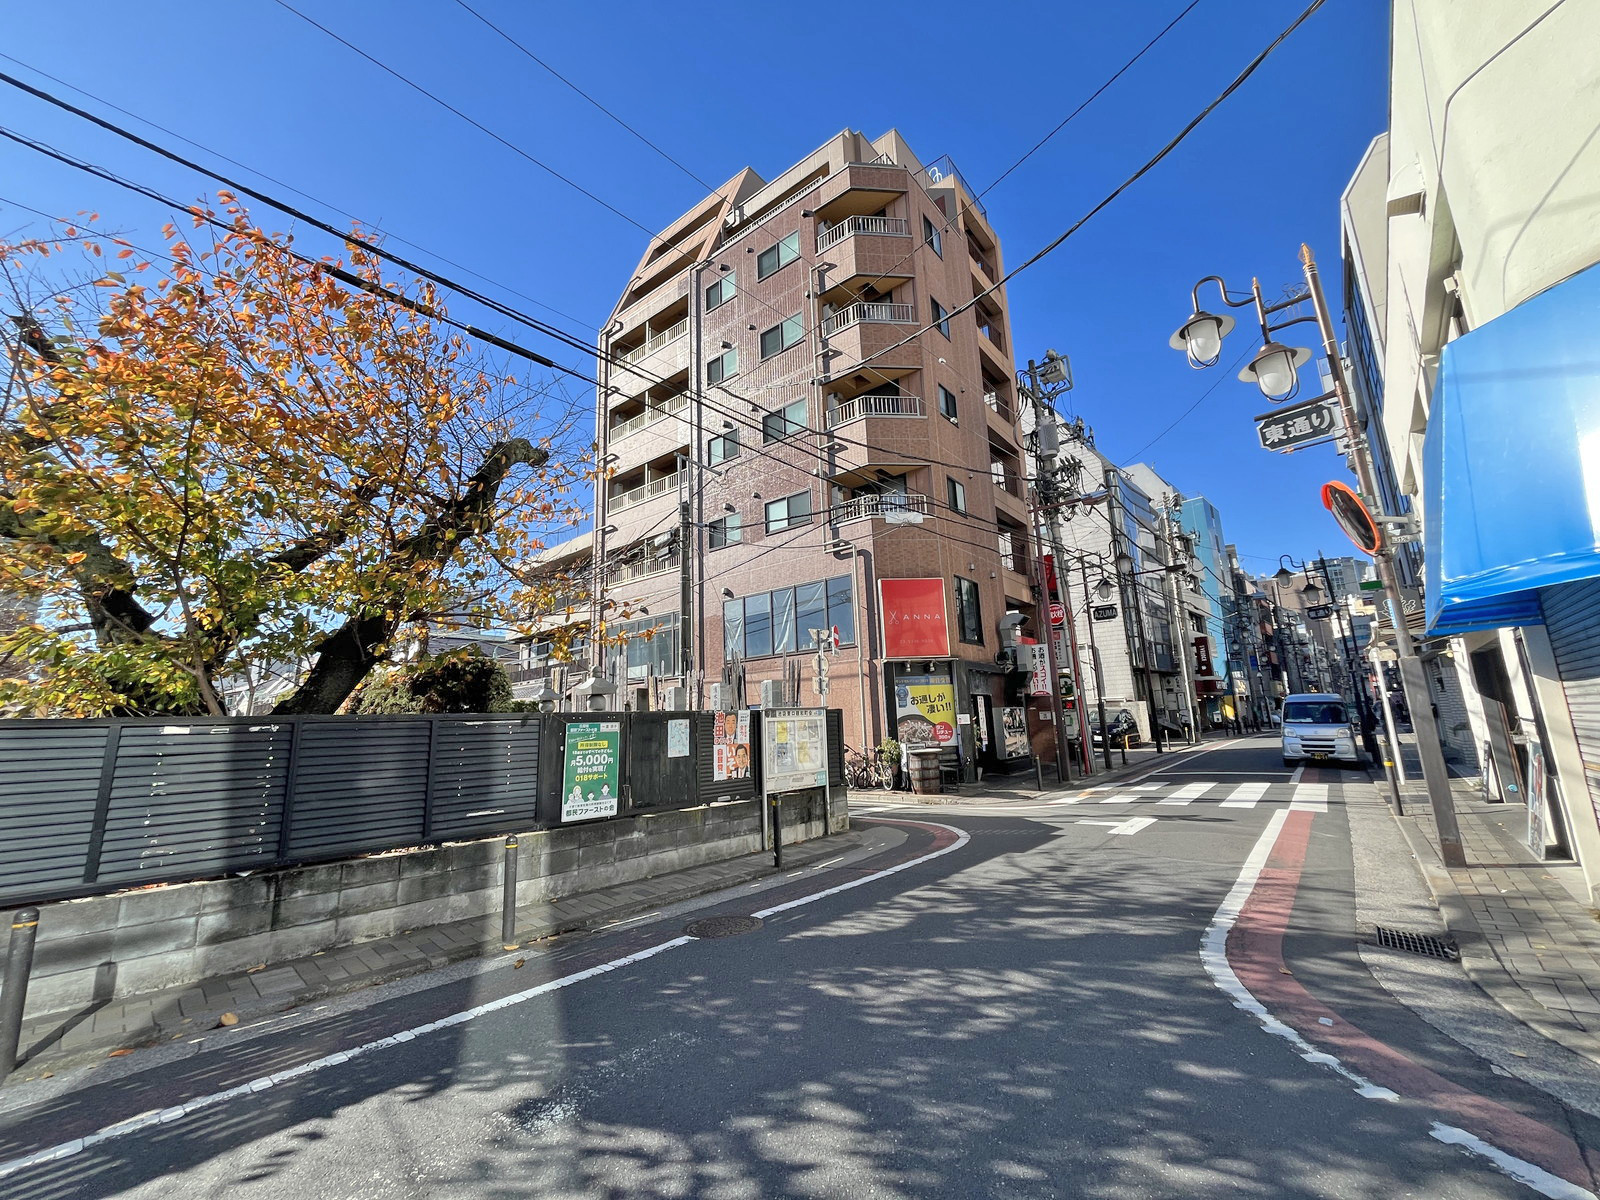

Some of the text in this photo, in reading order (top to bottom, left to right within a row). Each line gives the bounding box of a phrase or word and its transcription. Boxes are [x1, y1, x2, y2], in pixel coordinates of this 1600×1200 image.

[1262, 409, 1331, 445] 東通り
[903, 613, 941, 621] ANNA
[1095, 609, 1117, 618] AZUMA
[910, 692, 946, 706] お通しが
[926, 701, 952, 715] 凄い!!
[715, 711, 725, 737] 池田
[570, 753, 614, 767] 月5,000円
[577, 765, 607, 774] 給付を実現!
[575, 773, 608, 782] 018サポート
[566, 804, 614, 817] 都民ファーストの会
